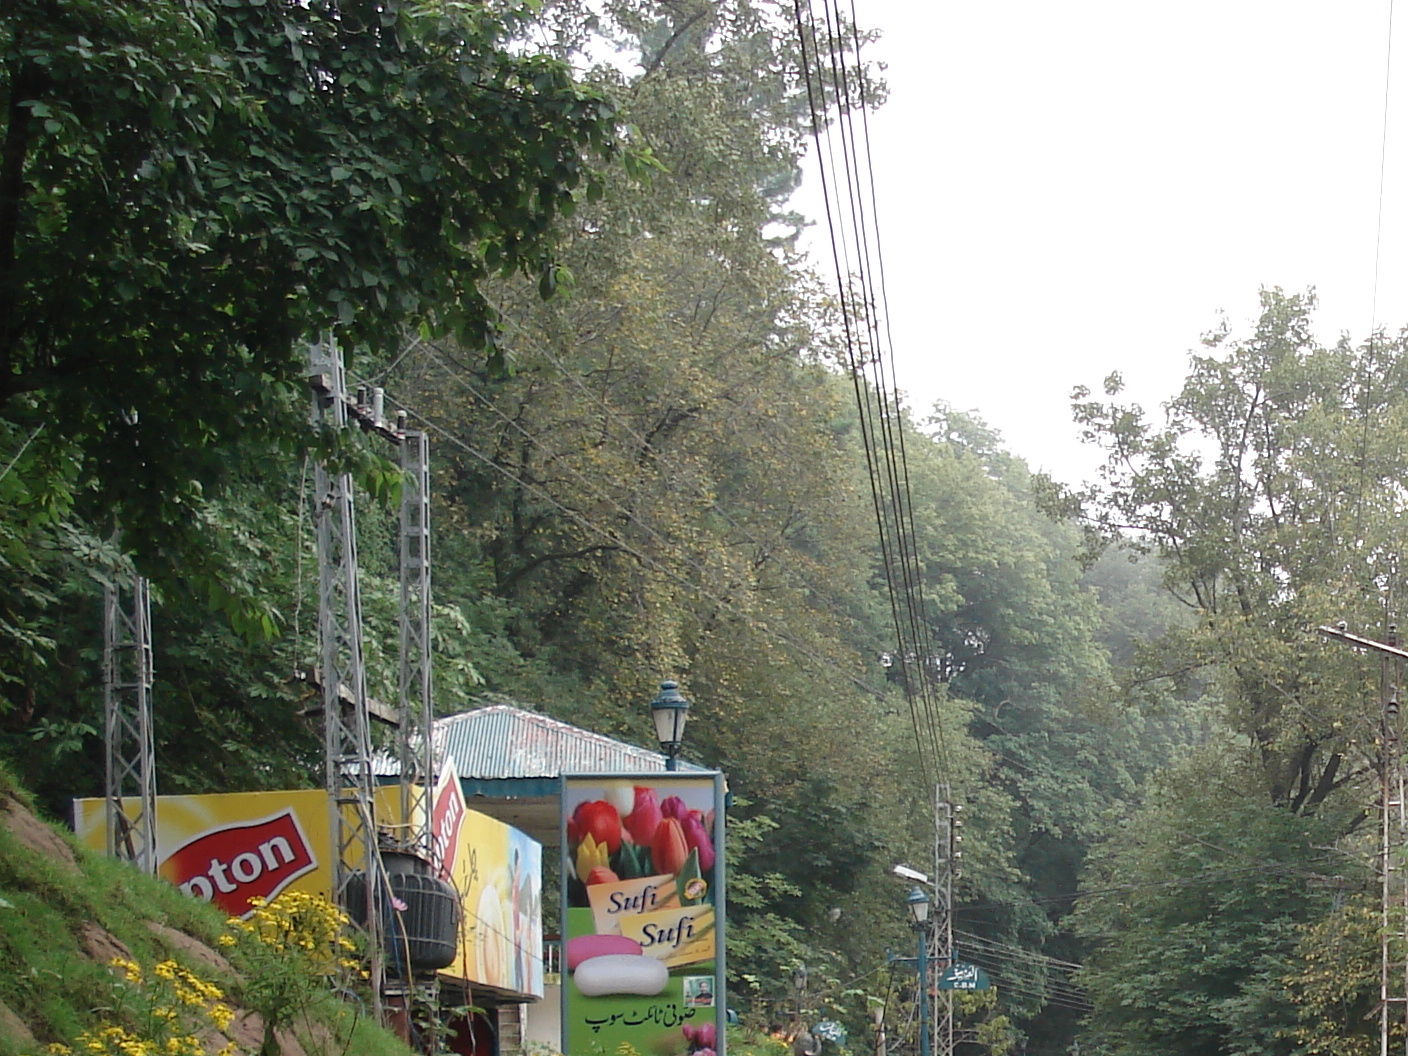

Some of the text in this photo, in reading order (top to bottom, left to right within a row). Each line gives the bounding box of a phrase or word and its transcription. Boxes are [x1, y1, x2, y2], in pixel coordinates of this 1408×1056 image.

[607, 885, 658, 914] Sufi
[640, 916, 695, 948] Sufi
[585, 1012, 625, 1033] سوپ
